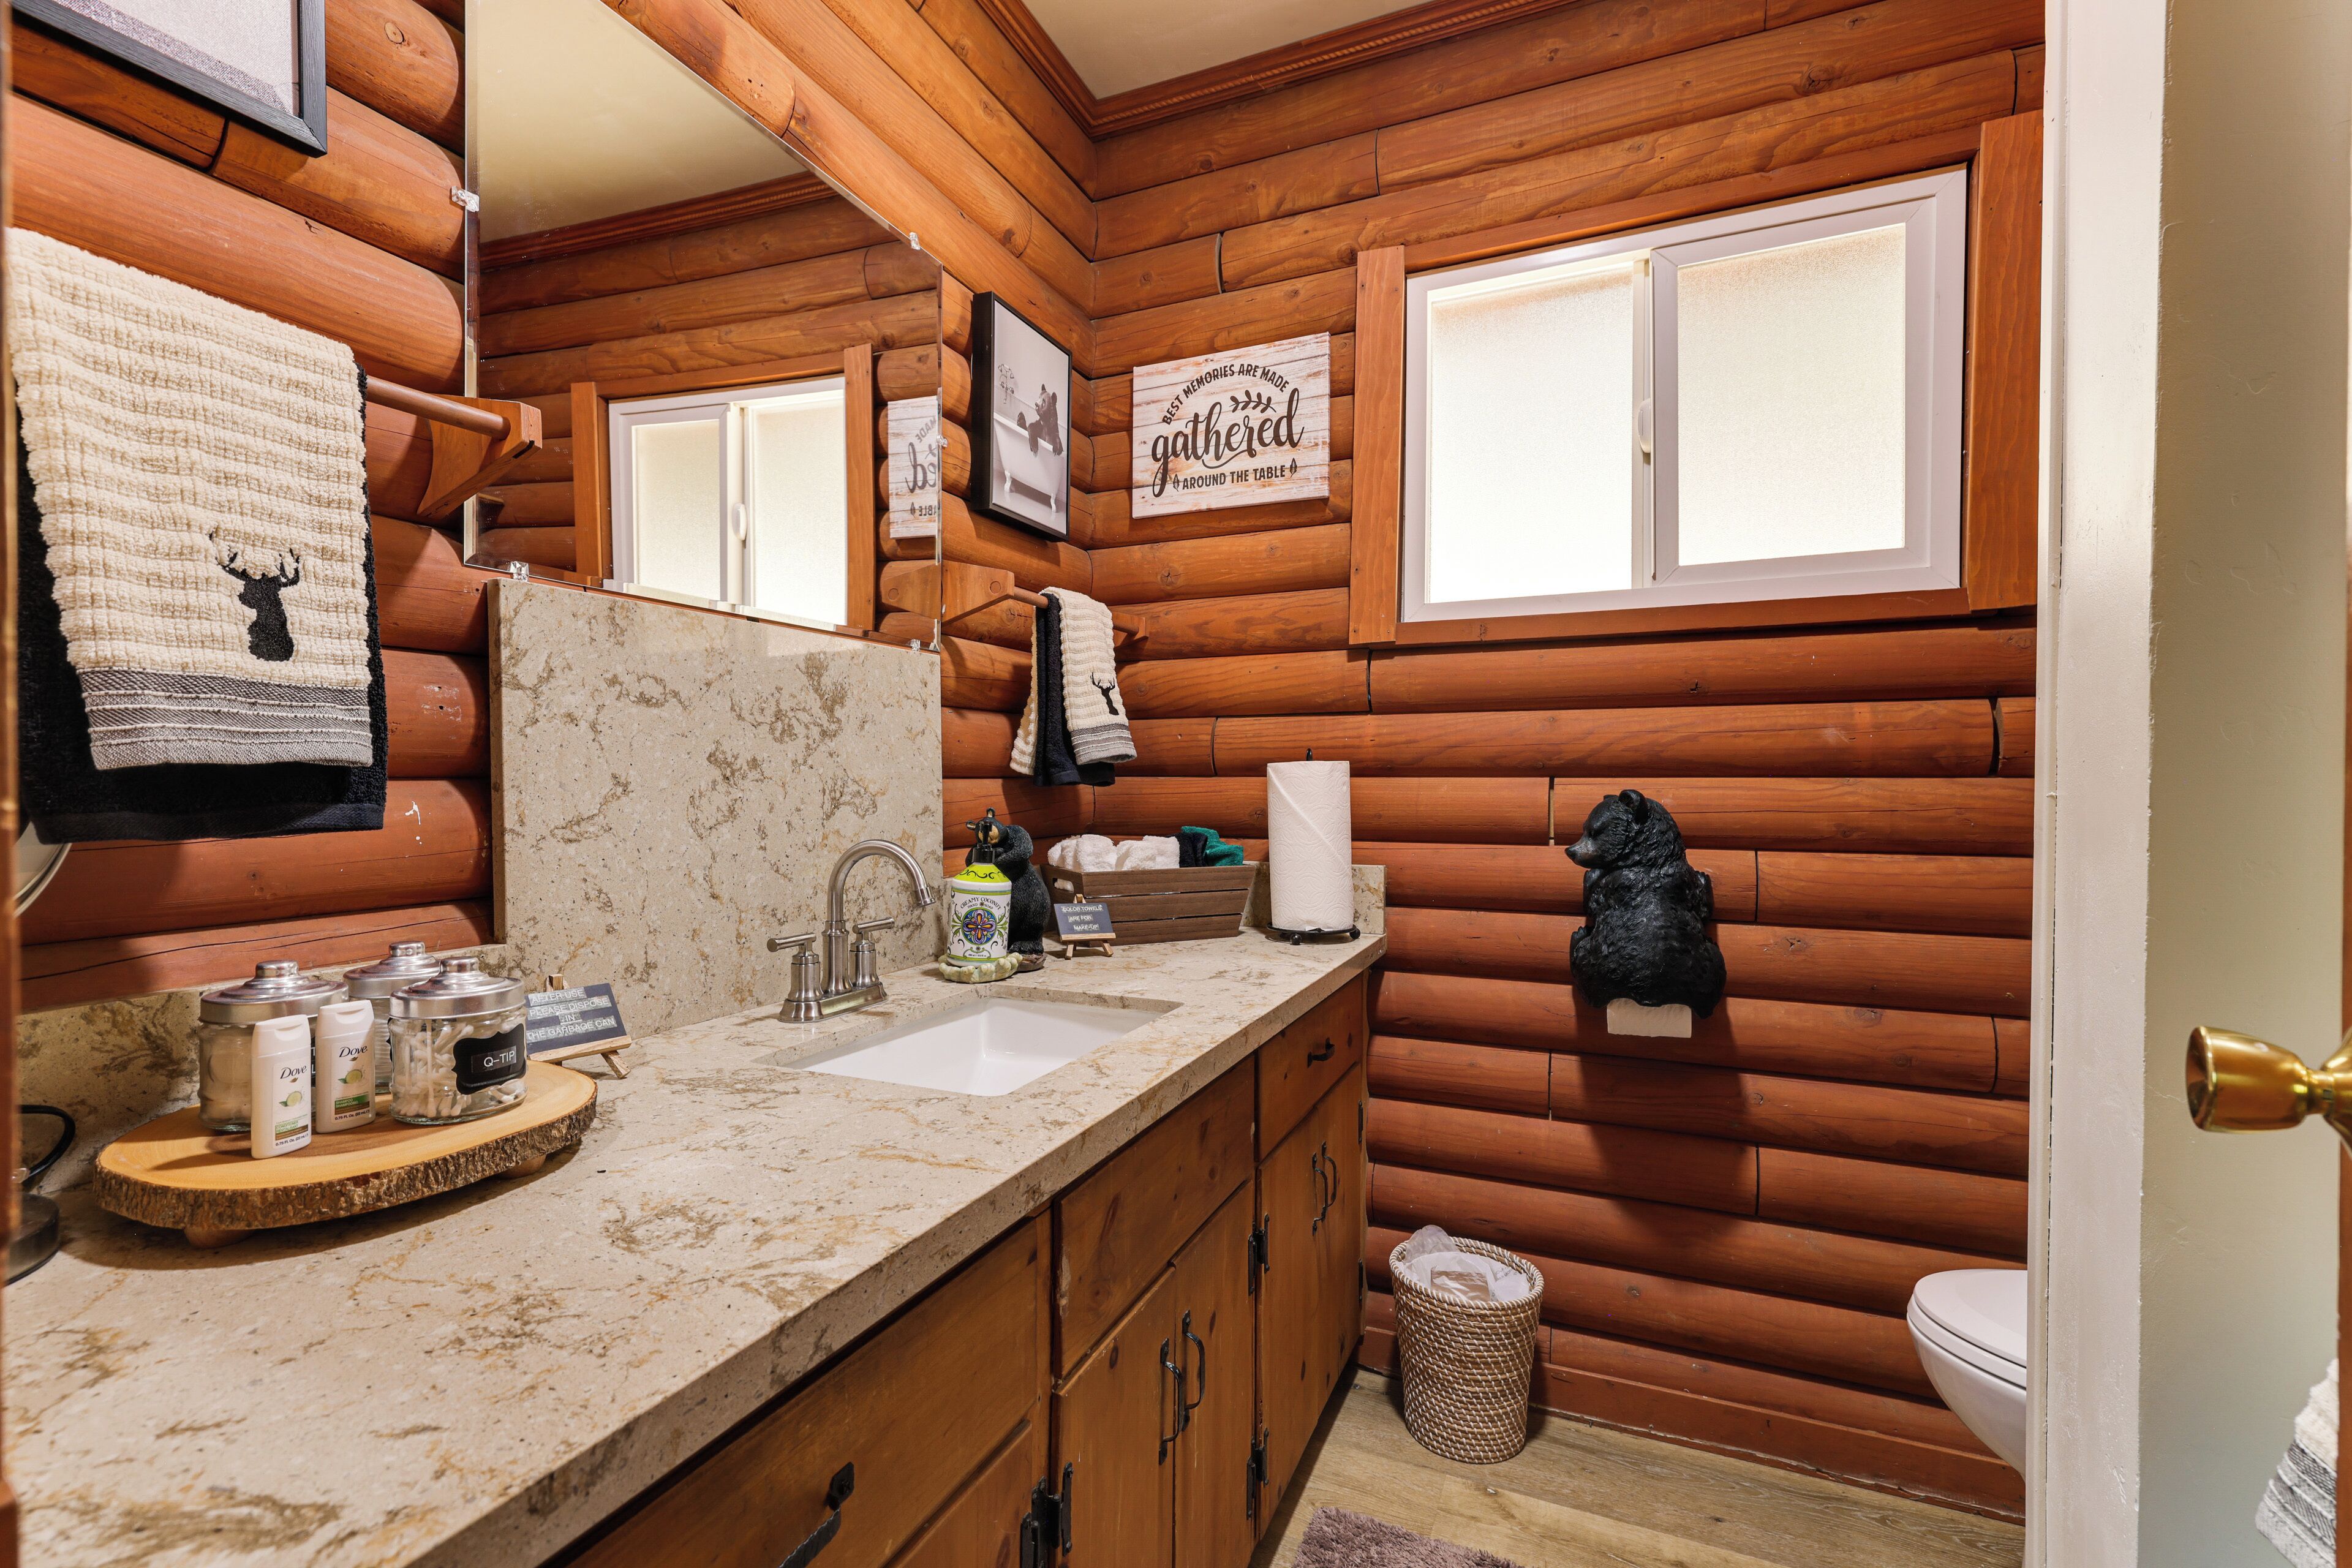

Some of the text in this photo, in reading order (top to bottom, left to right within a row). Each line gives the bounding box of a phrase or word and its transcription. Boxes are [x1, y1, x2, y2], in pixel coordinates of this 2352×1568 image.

[1162, 363, 1289, 425] BEST MEMORIES ARE MADE
[1151, 387, 1305, 498] gathered
[1182, 465, 1286, 491] AROUND THE TABLE
[960, 897, 1001, 910] CREAMY COCONUT
[532, 989, 584, 1003] AFTER USE
[529, 998, 609, 1017] PLEASE DISPOSE
[527, 1018, 615, 1040] THE GARBAGE CAN
[339, 1046, 368, 1058] Dove
[483, 1050, 515, 1067] Q-TIP
[280, 1065, 307, 1079] Dove
